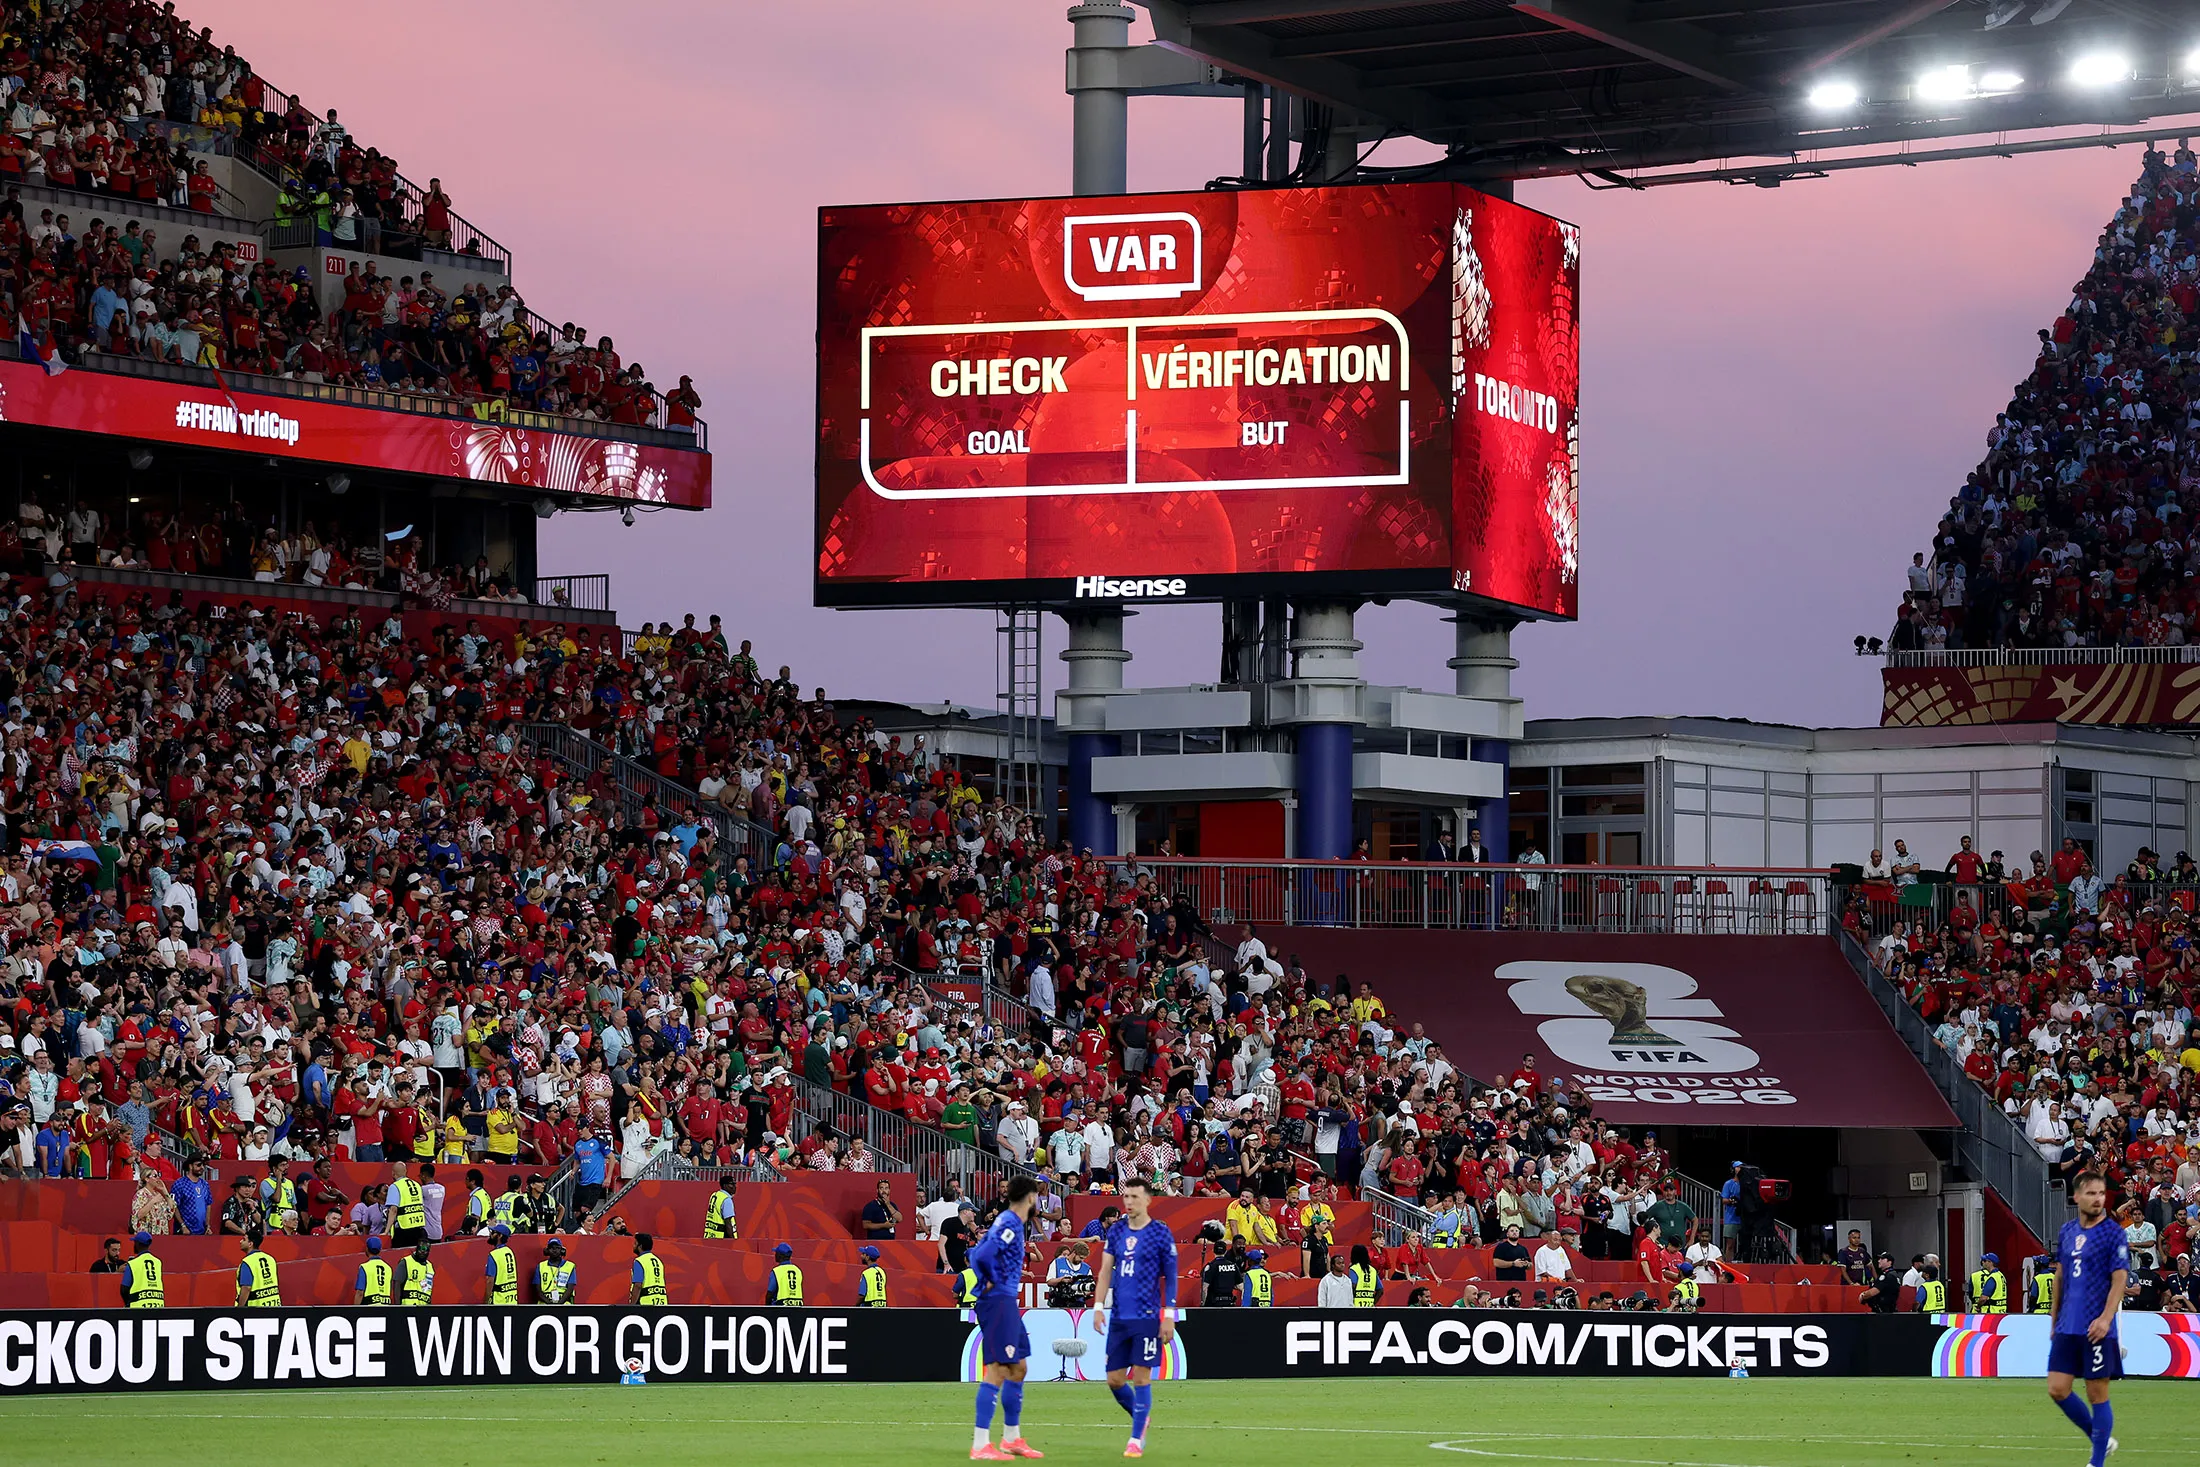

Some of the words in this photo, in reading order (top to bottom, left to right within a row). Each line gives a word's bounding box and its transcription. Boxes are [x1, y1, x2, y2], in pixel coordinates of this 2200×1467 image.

[239, 245, 256, 260] 210
[1089, 234, 1176, 273] VAR
[328, 259, 343, 273] 211
[930, 356, 1068, 397] CHECK
[1141, 343, 1391, 391] VÉRIFICATION
[1474, 372, 1558, 434] TORONTO
[967, 429, 1031, 455] GOAL
[1242, 421, 1289, 446] BUT
[1075, 575, 1187, 598] Hisense
[947, 990, 966, 1001] FIFA
[432, 1027, 444, 1046] 23
[1091, 1037, 1101, 1054] 7
[1610, 1050, 1709, 1064] FIFA
[1570, 1073, 1705, 1088] WORLD
[1709, 1076, 1781, 1088] CUP
[1582, 1086, 1798, 1106] 2026
[1317, 1116, 1324, 1133] 9
[1912, 1176, 1926, 1187] EXIT
[494, 1201, 511, 1210] POLICE
[1120, 1259, 1136, 1277] 14
[1218, 1264, 1236, 1273] POLICE
[2072, 1259, 2083, 1278] 3
[0, 1318, 195, 1387] CKOUT
[205, 1315, 387, 1381] STAGE
[406, 1315, 512, 1377] WIN
[527, 1314, 600, 1376] OR
[615, 1314, 690, 1376] GO
[704, 1315, 848, 1375] HOME
[1143, 1337, 1158, 1355] 14
[1286, 1319, 1829, 1368] FIFA.COM/TICKETS
[2091, 1346, 2104, 1365] 3
